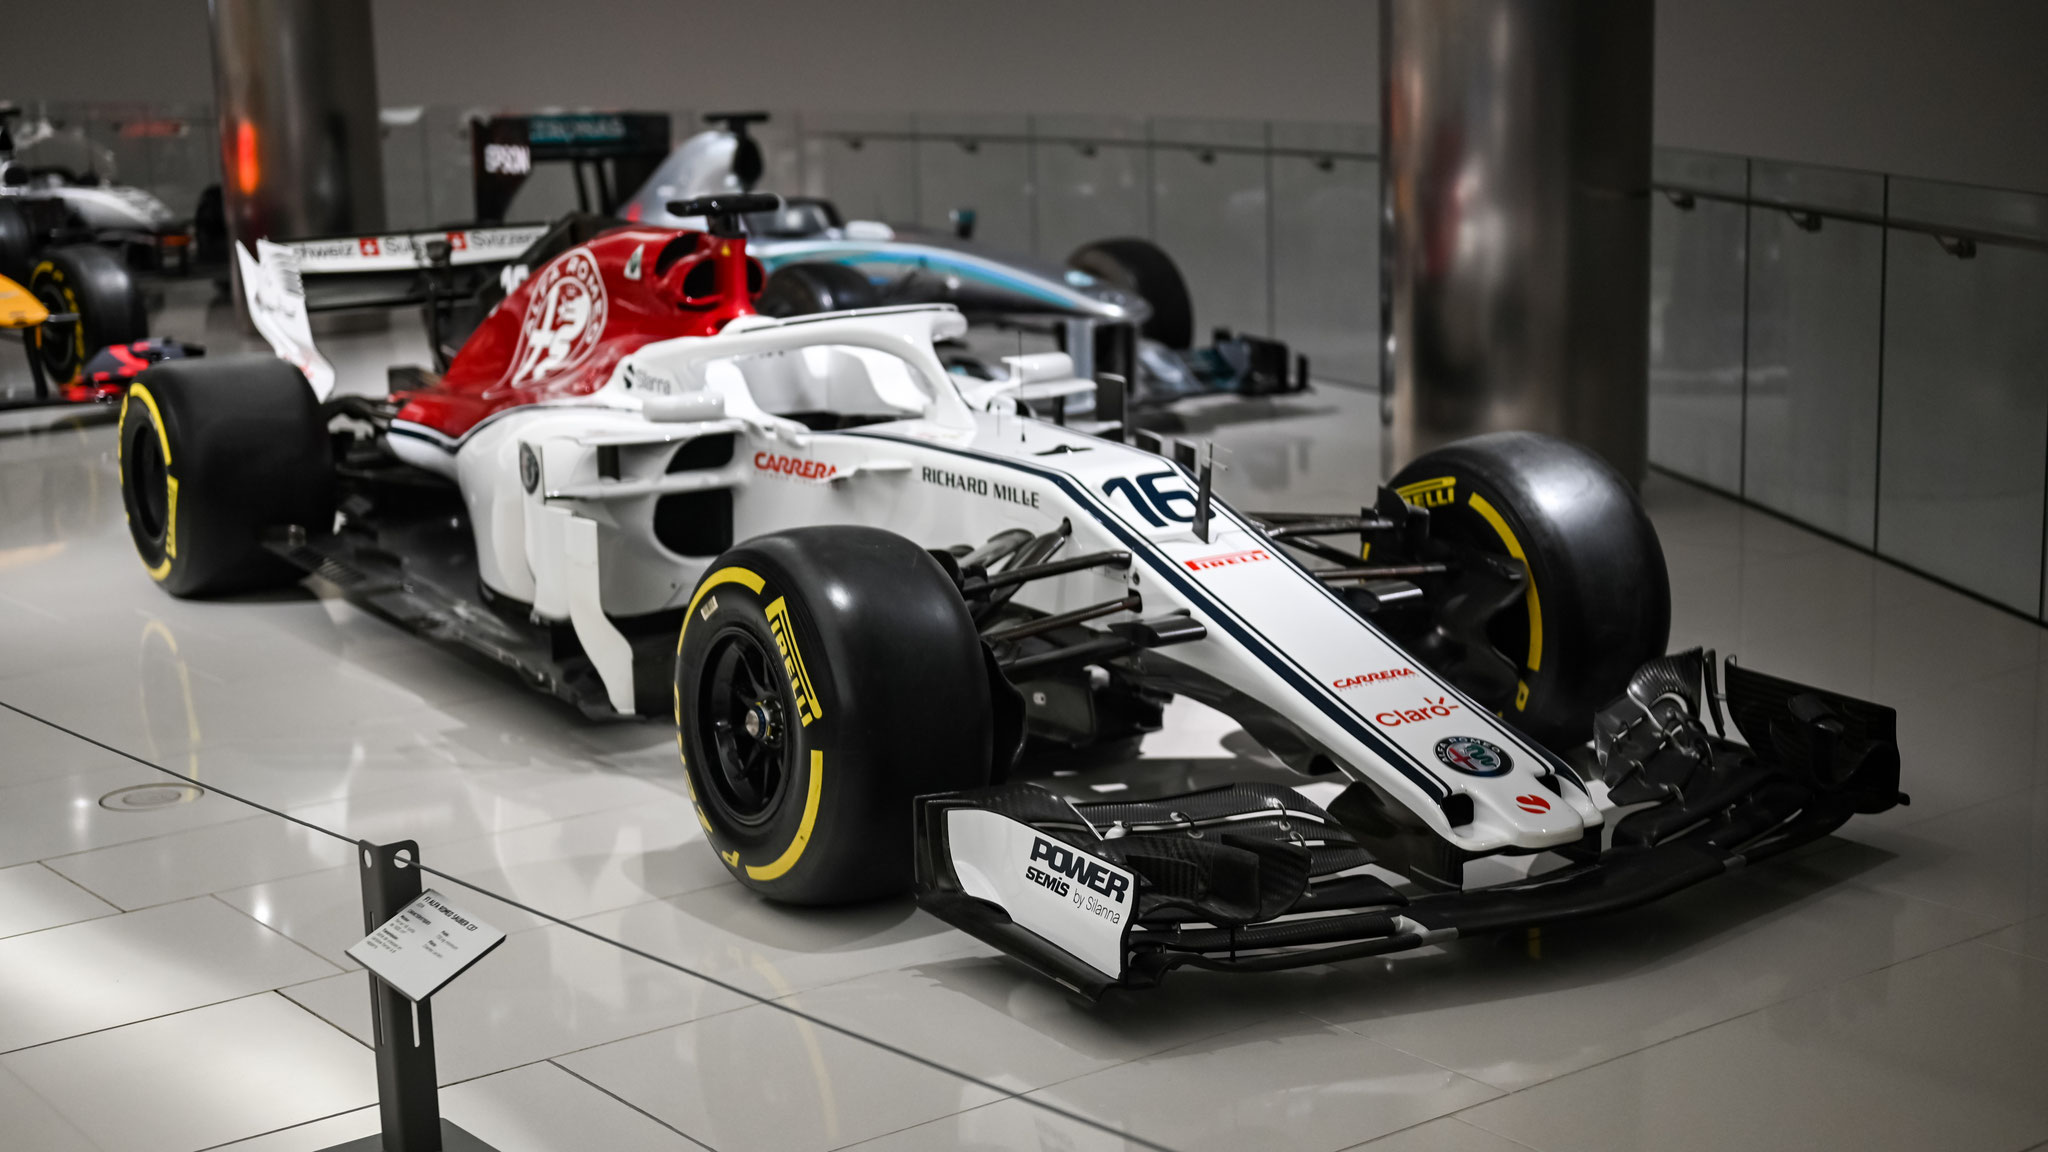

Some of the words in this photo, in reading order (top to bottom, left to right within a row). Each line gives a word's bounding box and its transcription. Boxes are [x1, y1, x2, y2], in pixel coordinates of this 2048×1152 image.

[566, 256, 603, 344] ROMEO
[754, 451, 837, 479] CARRERA
[922, 466, 988, 496] RICHARD
[993, 484, 1040, 509] MILLE
[1102, 471, 1217, 528] 16
[1397, 476, 1456, 507] ELLI
[1184, 550, 1270, 571] PIRELLI
[765, 595, 823, 727] PIRELLI
[1333, 667, 1416, 688] CARRERA
[1375, 697, 1459, 727] Claro
[1438, 743, 1449, 763] ALFA
[1448, 737, 1500, 753] ROMEO
[1030, 836, 1129, 904] POWER
[439, 905, 455, 917] ROMEO
[1073, 888, 1085, 909] by
[1085, 896, 1121, 924] Silanna
